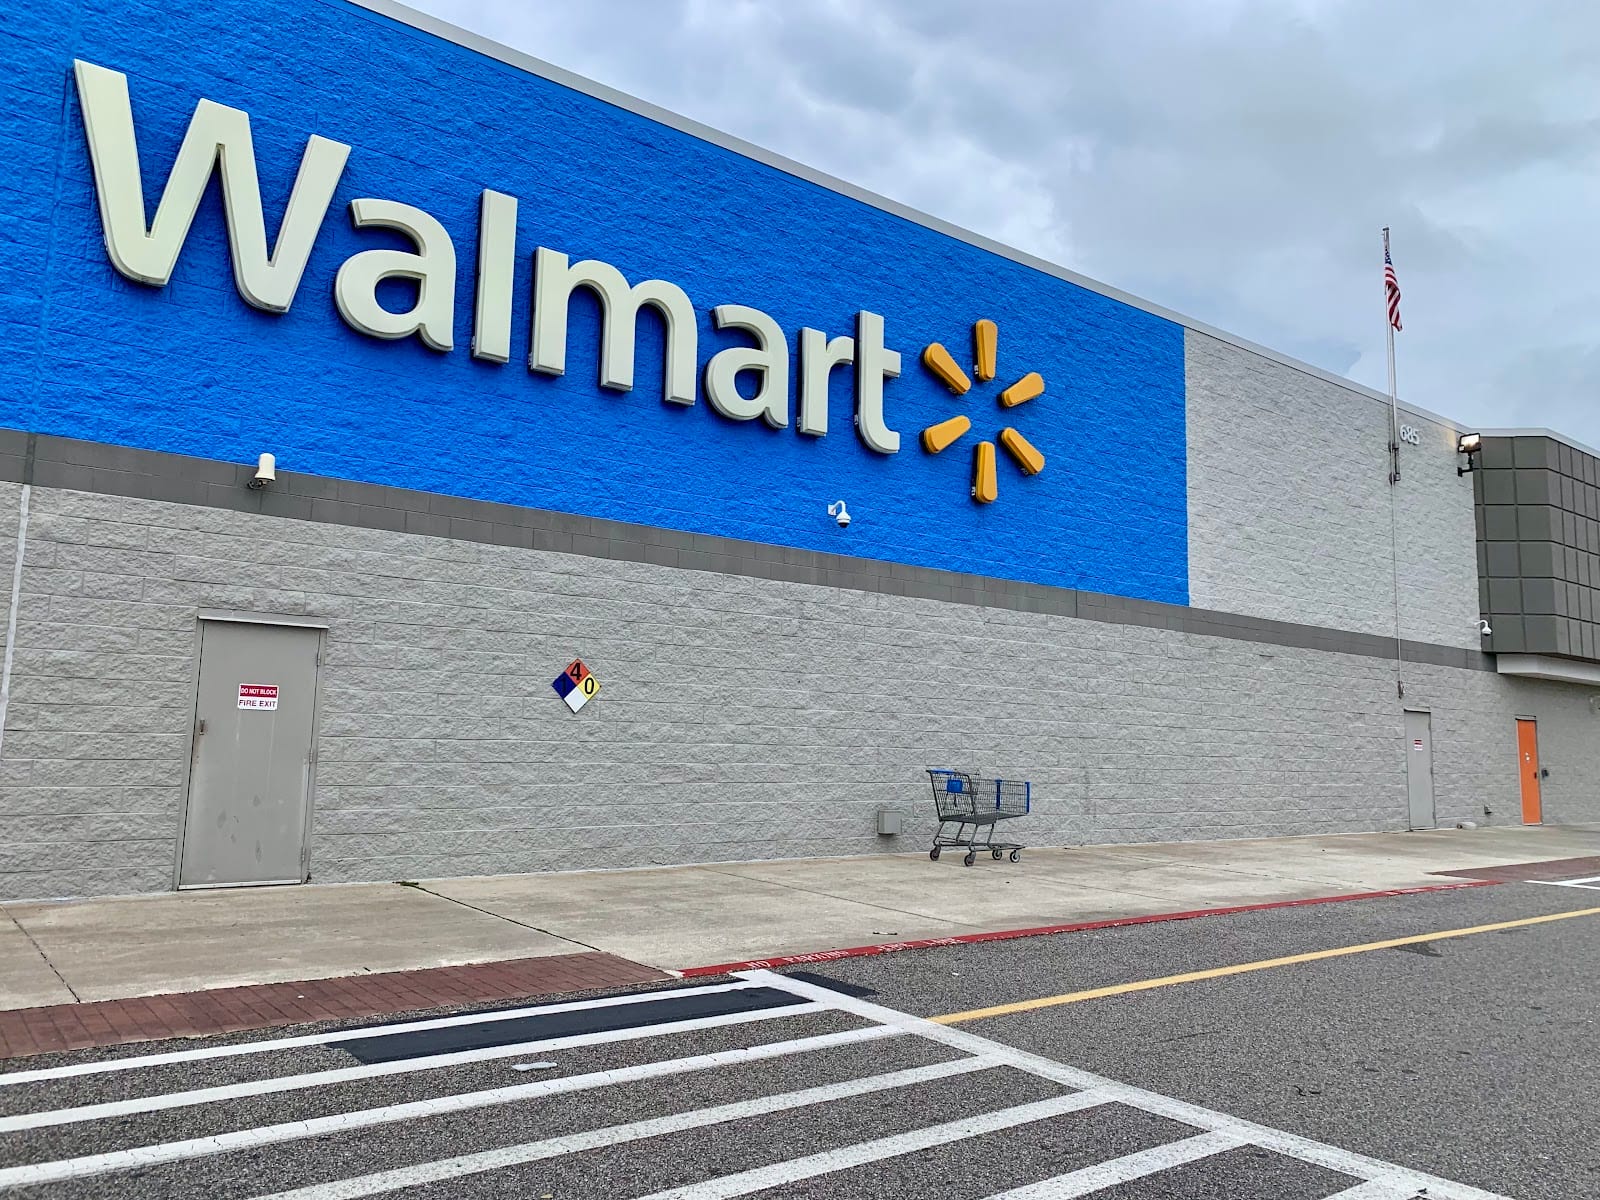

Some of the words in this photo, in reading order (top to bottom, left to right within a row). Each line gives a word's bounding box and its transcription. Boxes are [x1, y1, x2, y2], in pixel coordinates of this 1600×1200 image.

[73, 58, 903, 455] Walmart
[1400, 424, 1420, 445] 685
[570, 662, 582, 681] 4
[584, 677, 594, 695] 0
[238, 699, 257, 707] FIRE
[259, 700, 277, 708] EXIT
